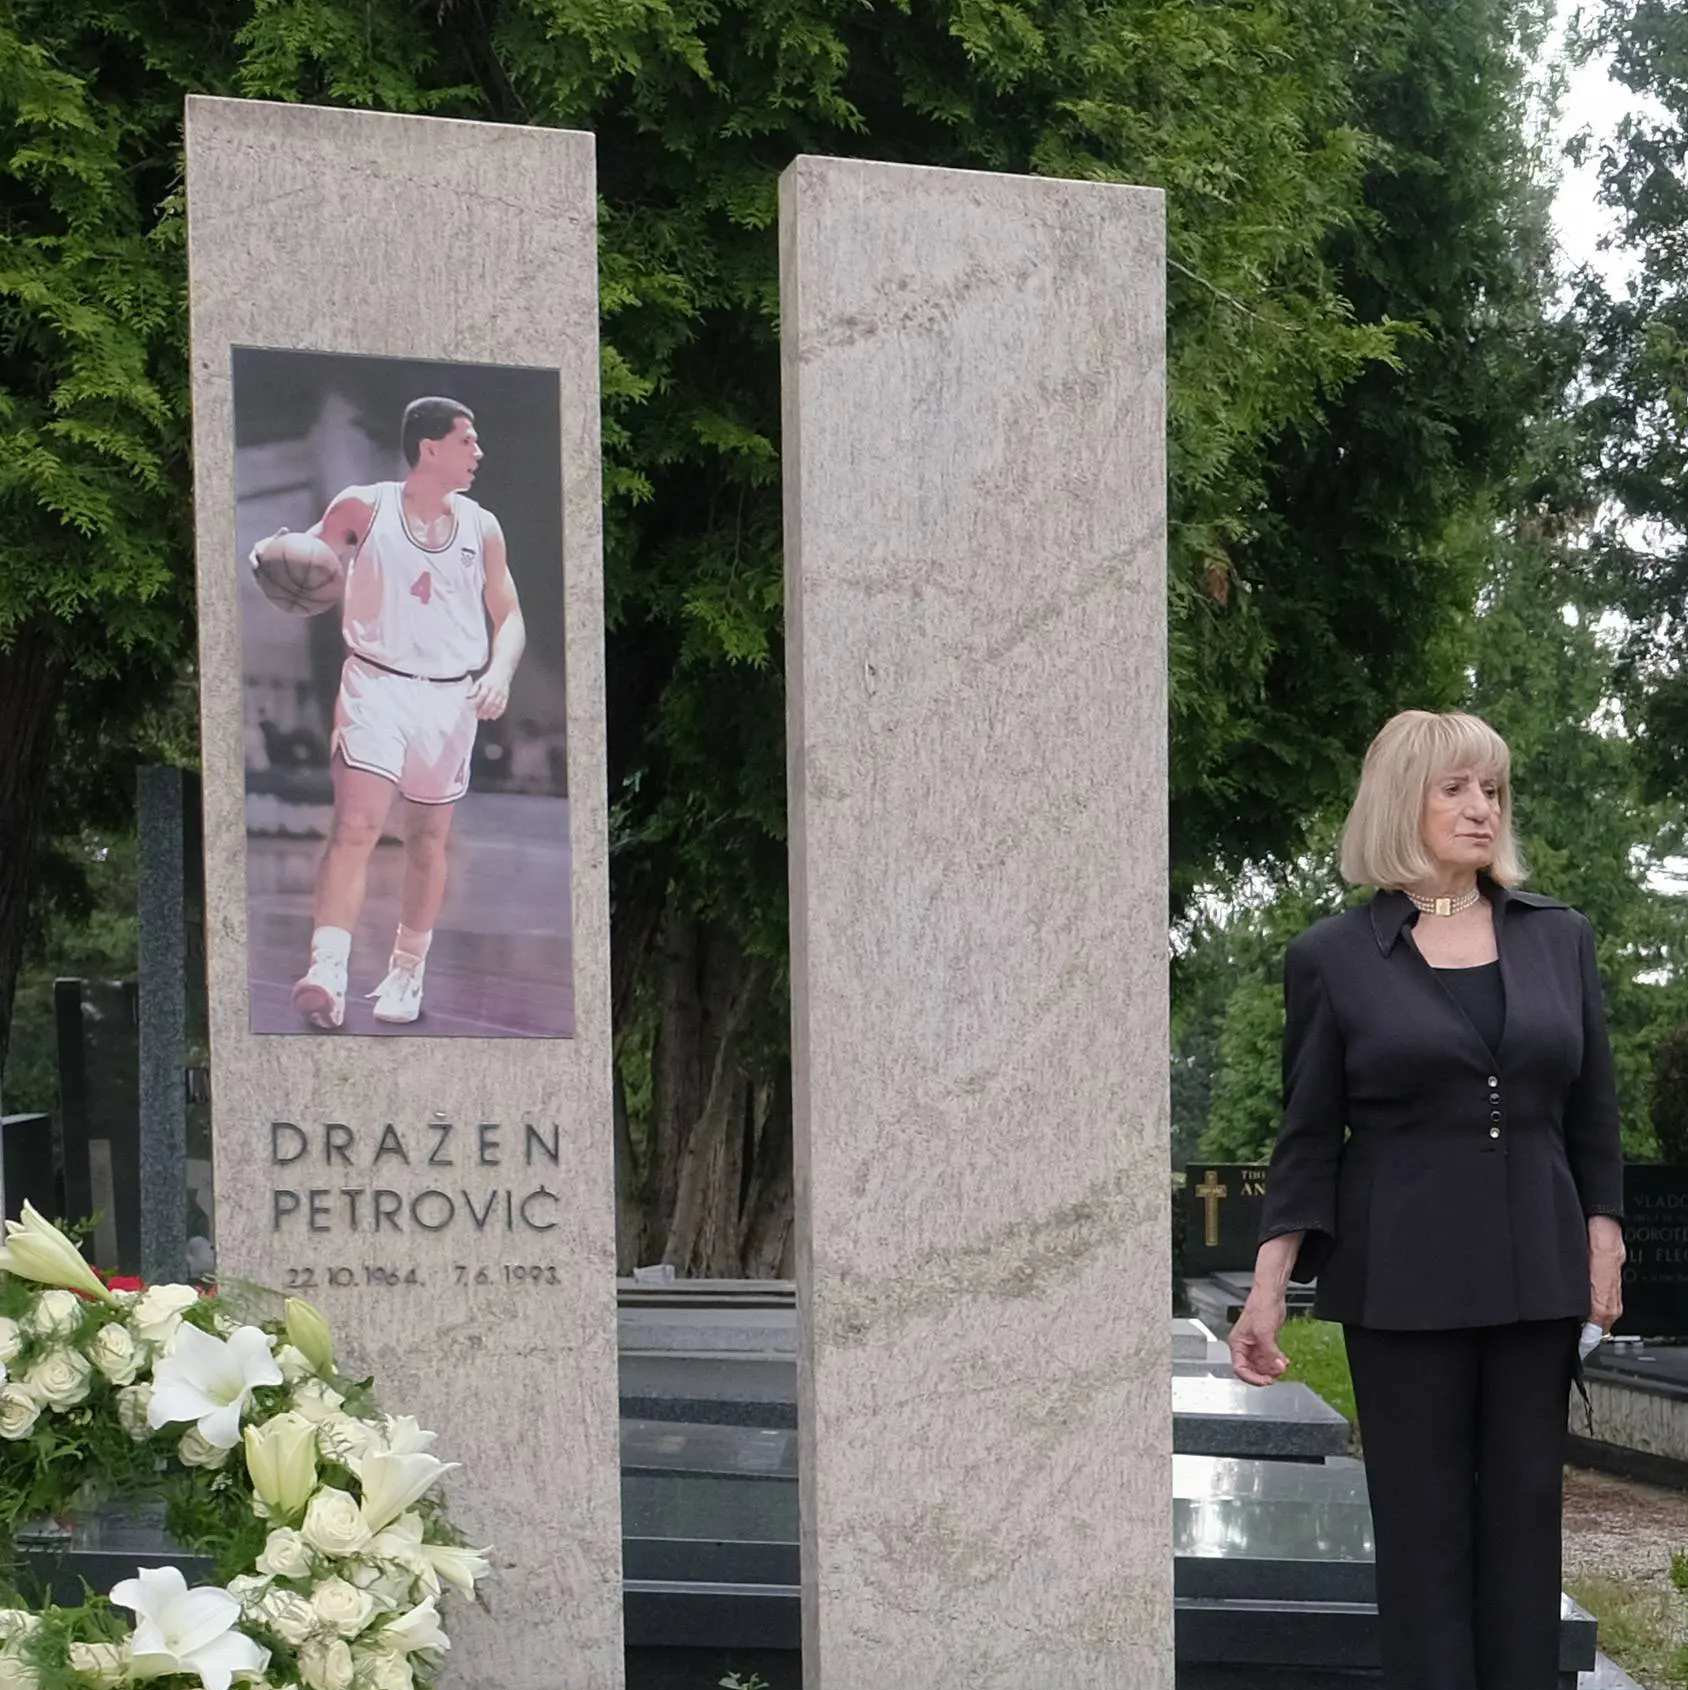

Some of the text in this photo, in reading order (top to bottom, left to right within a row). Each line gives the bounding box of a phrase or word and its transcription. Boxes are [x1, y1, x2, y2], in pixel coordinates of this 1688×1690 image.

[410, 571, 431, 605] 4
[271, 1111, 560, 1167] DRAŽEN
[273, 1184, 561, 1233] PETROVIĆ
